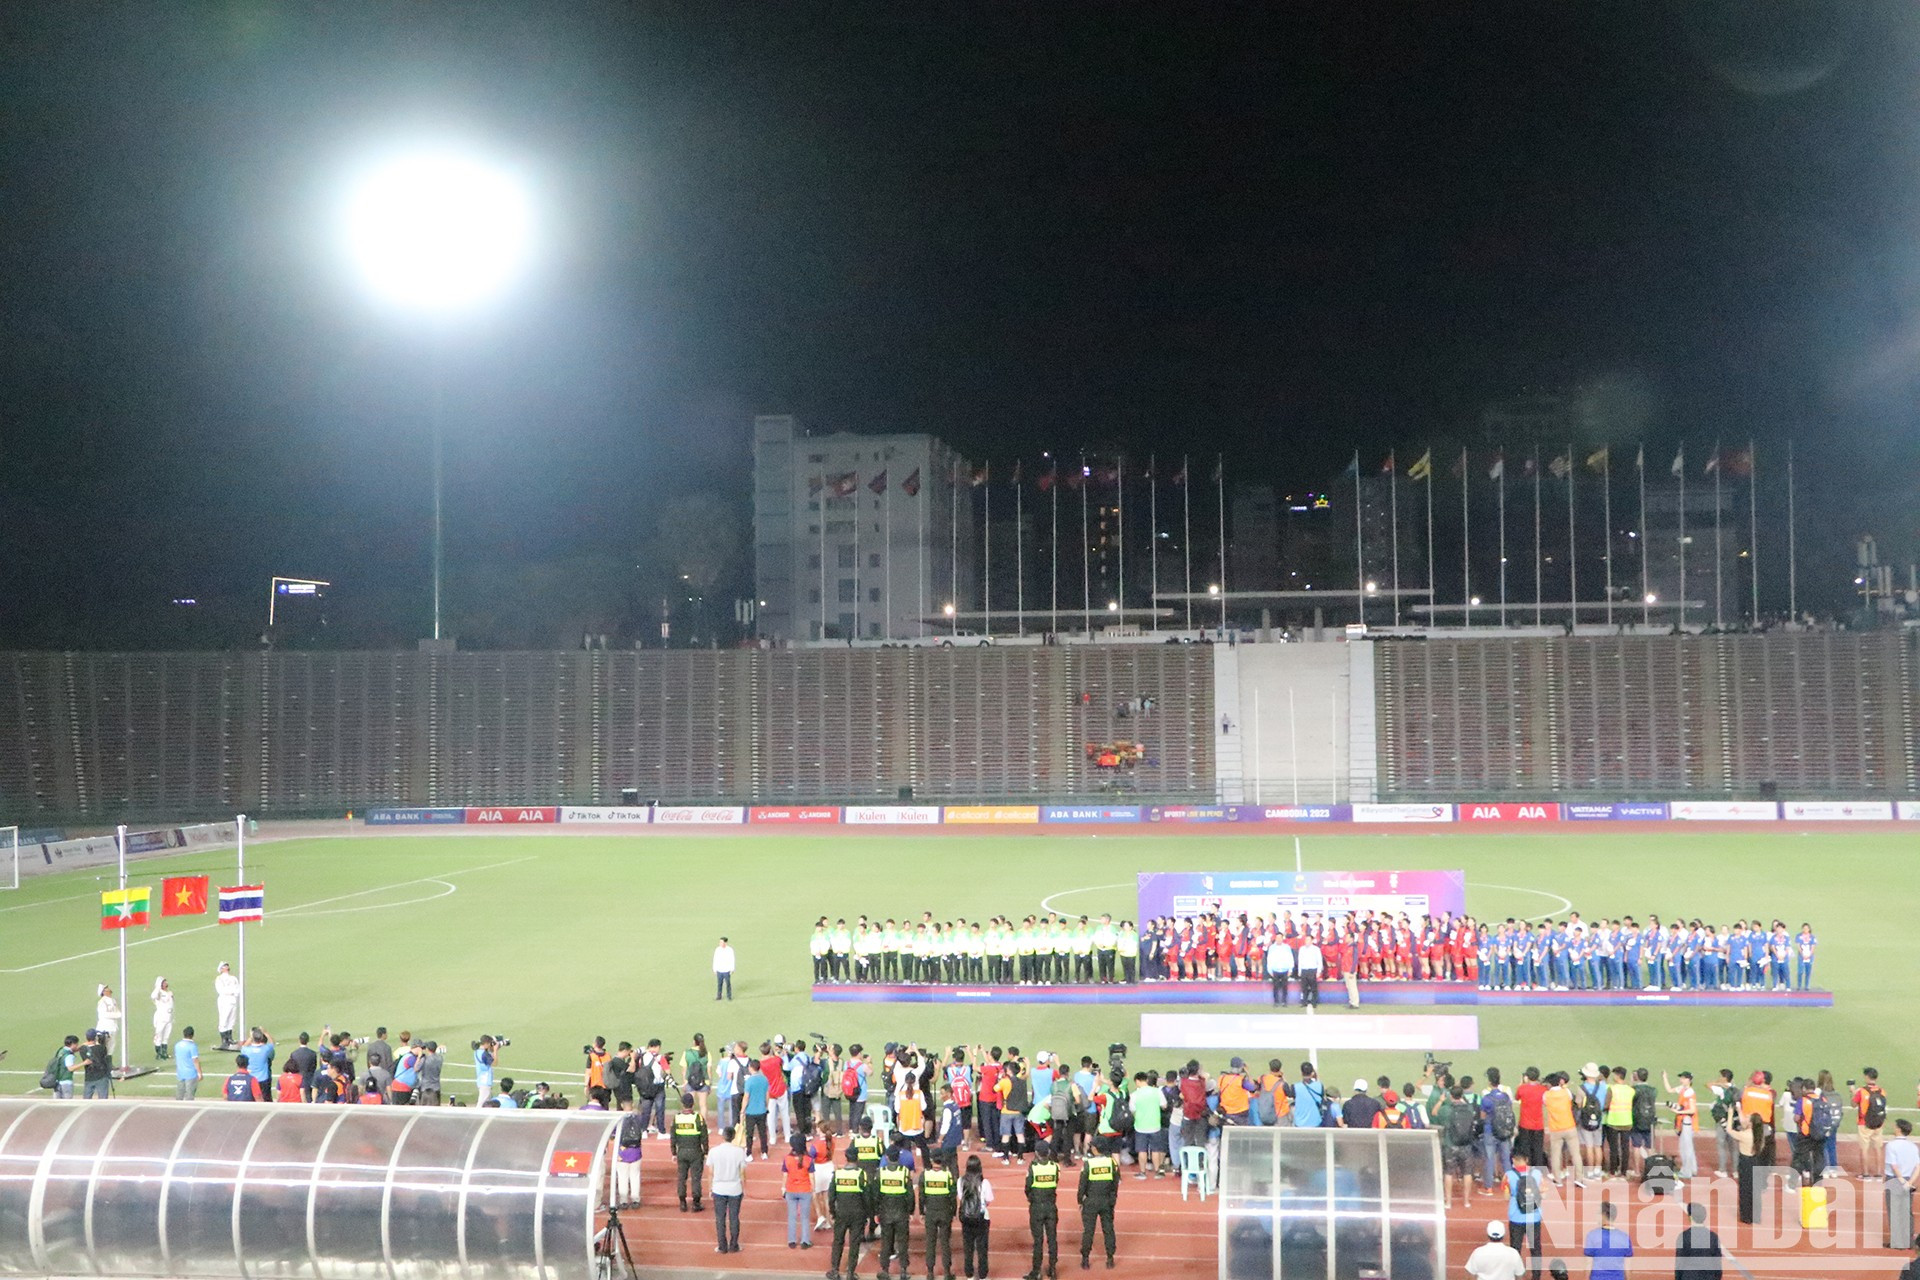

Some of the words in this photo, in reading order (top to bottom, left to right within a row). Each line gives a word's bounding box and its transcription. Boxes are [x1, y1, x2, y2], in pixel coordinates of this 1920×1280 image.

[477, 810, 503, 821] AIA
[518, 810, 544, 821] AIA
[859, 811, 886, 820] Kulen
[901, 811, 928, 820] Kulen
[1265, 809, 1308, 818] CAMBODIA
[1310, 809, 1330, 818] 2023
[1472, 806, 1501, 819] AIA
[1517, 806, 1547, 819] AIA
